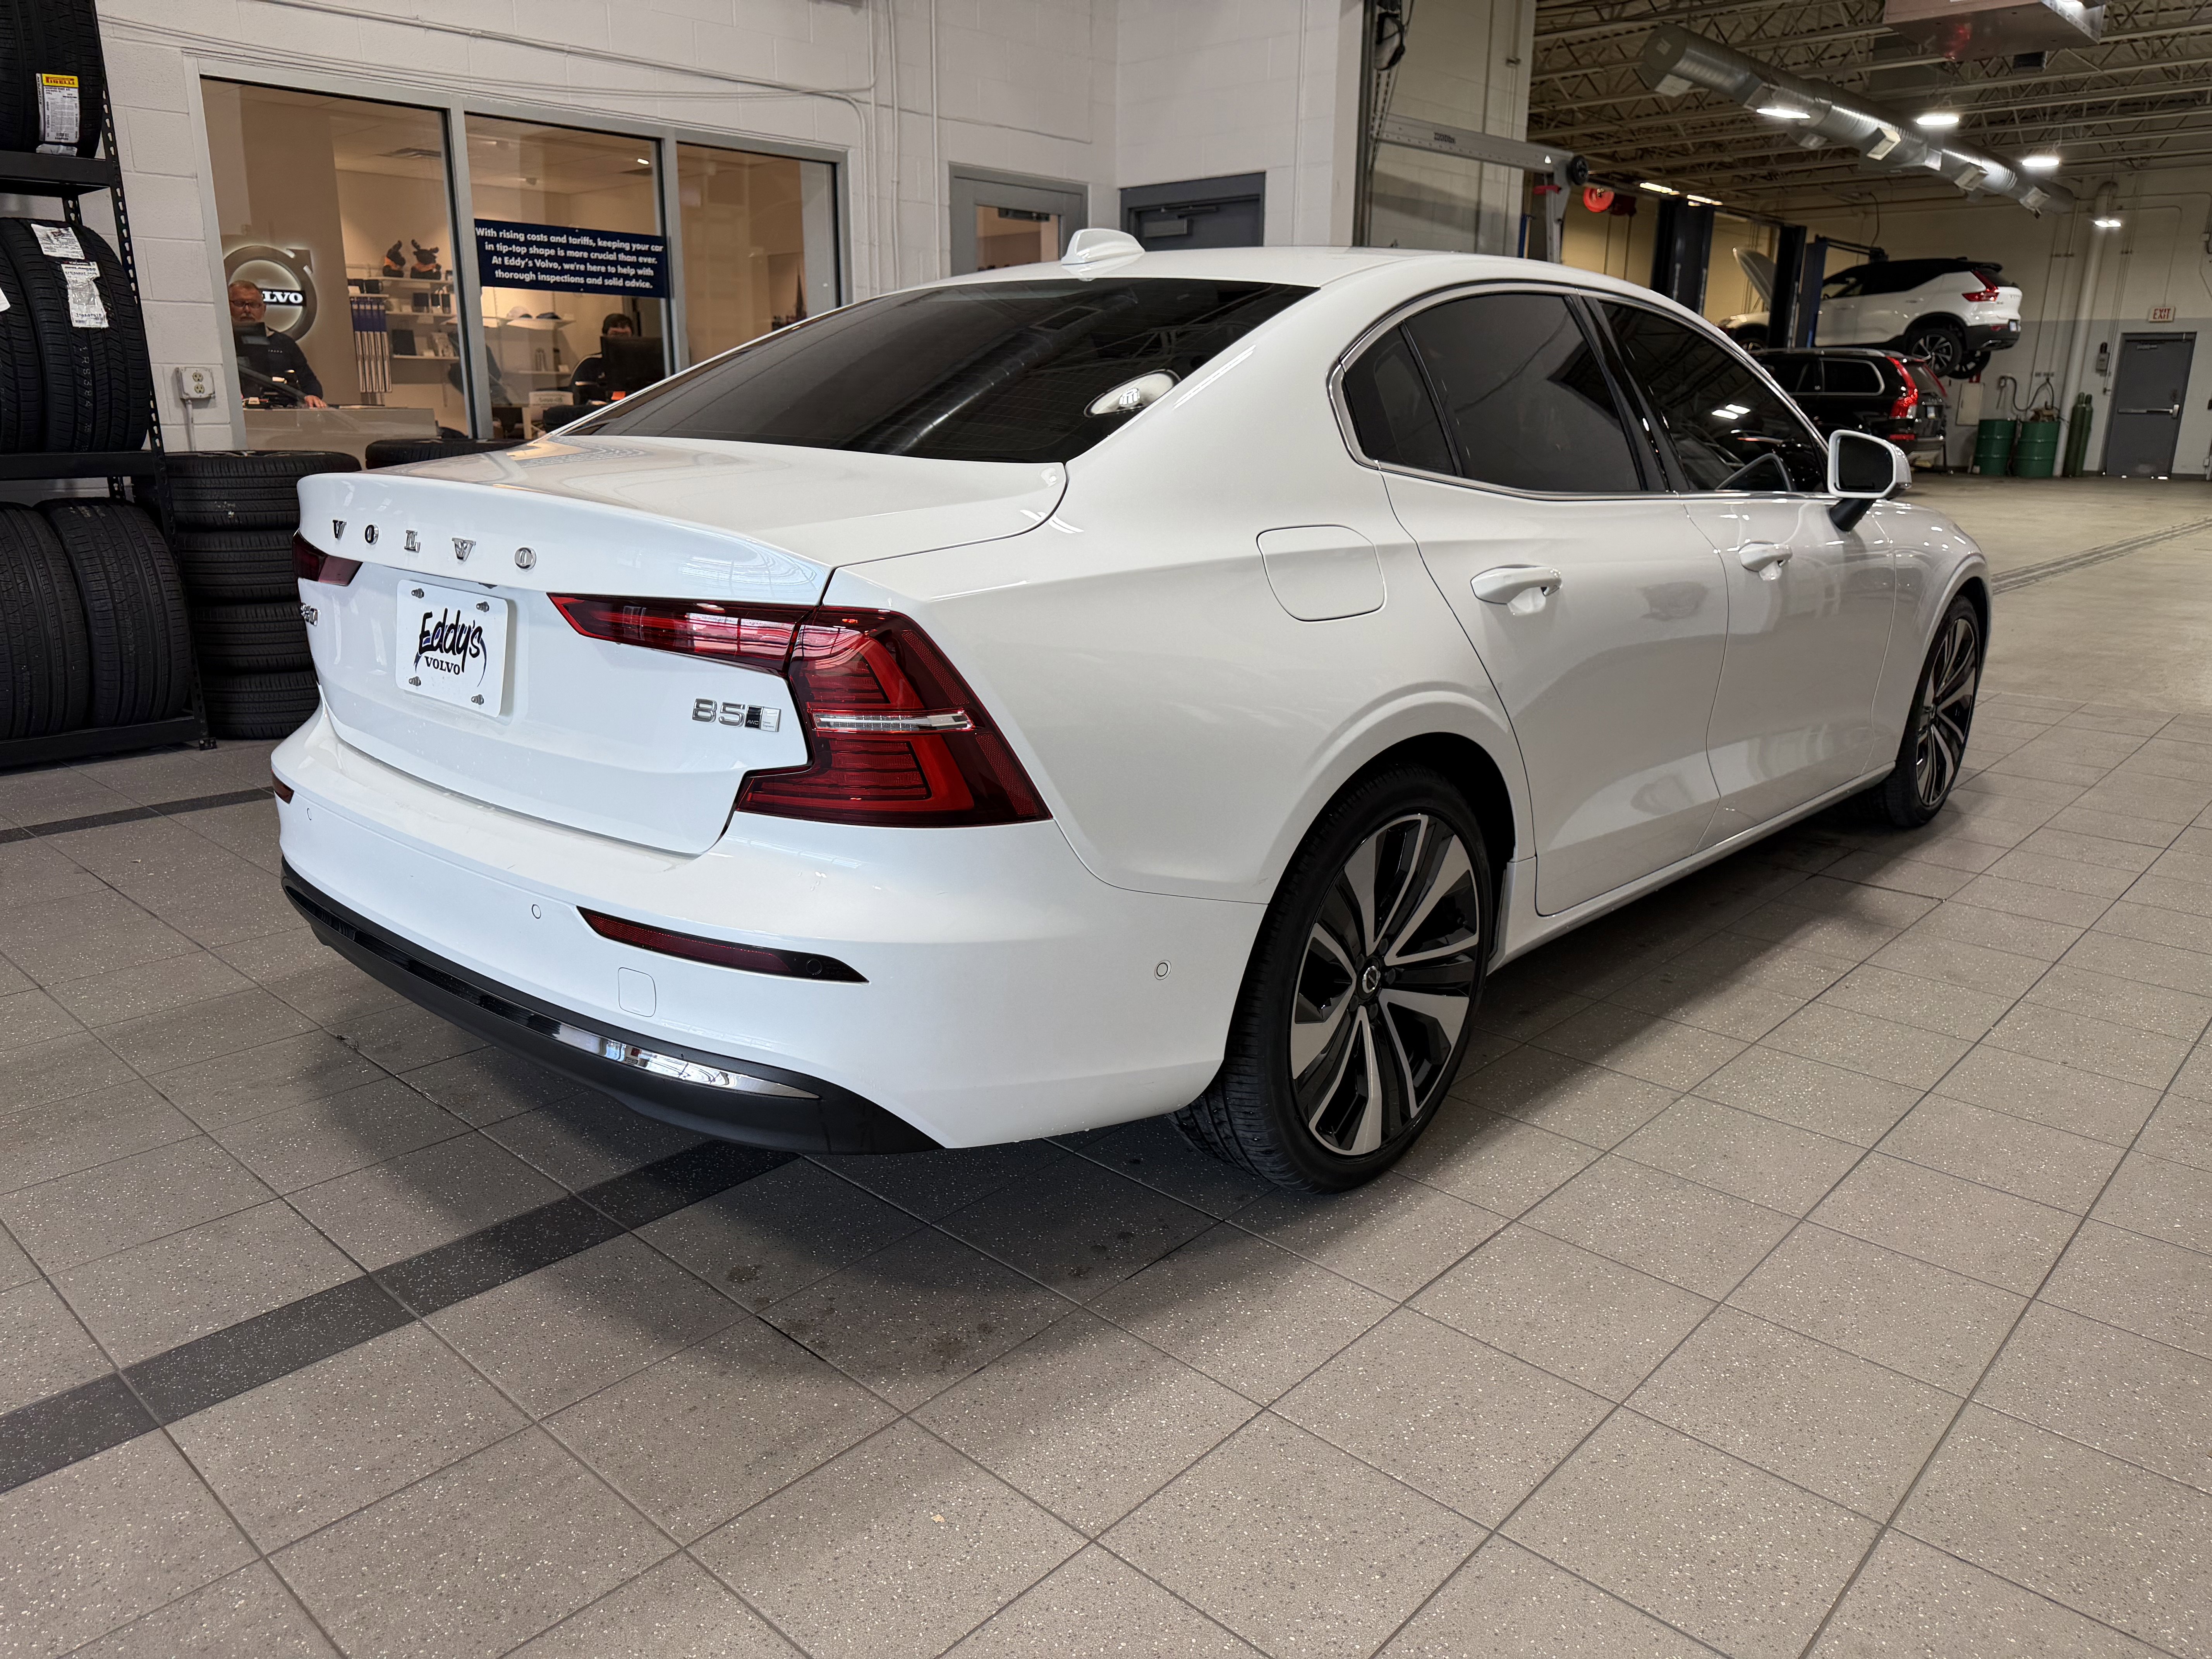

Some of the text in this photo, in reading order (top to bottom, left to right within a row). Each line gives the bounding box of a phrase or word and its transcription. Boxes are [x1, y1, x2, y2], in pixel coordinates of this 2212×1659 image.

[475, 227, 497, 237] With
[499, 230, 525, 241] rising
[527, 234, 548, 242] costs
[550, 234, 567, 243] and
[568, 236, 596, 247] tariffs,
[597, 238, 630, 251] keeping
[631, 243, 649, 251] your
[485, 241, 494, 250] in
[496, 242, 527, 255] tip-top
[529, 245, 555, 257] shape
[557, 247, 565, 256] is
[567, 250, 588, 258] more
[590, 252, 617, 260] crucial
[618, 252, 637, 262] than
[492, 256, 502, 264] At
[504, 256, 533, 268] Eddy's
[534, 259, 561, 270] Volvo,
[563, 262, 585, 271] we're
[587, 263, 606, 272] here
[617, 265, 635, 276] help
[637, 267, 654, 276] with
[495, 269, 653, 289] thorough inspections and solid advice.
[262, 291, 303, 304] LVO
[2153, 308, 2171, 319] EXIT
[333, 520, 537, 569] VOLVO
[419, 608, 483, 673] Eddy's
[424, 656, 460, 675] VOLVO
[692, 698, 745, 726] B5
